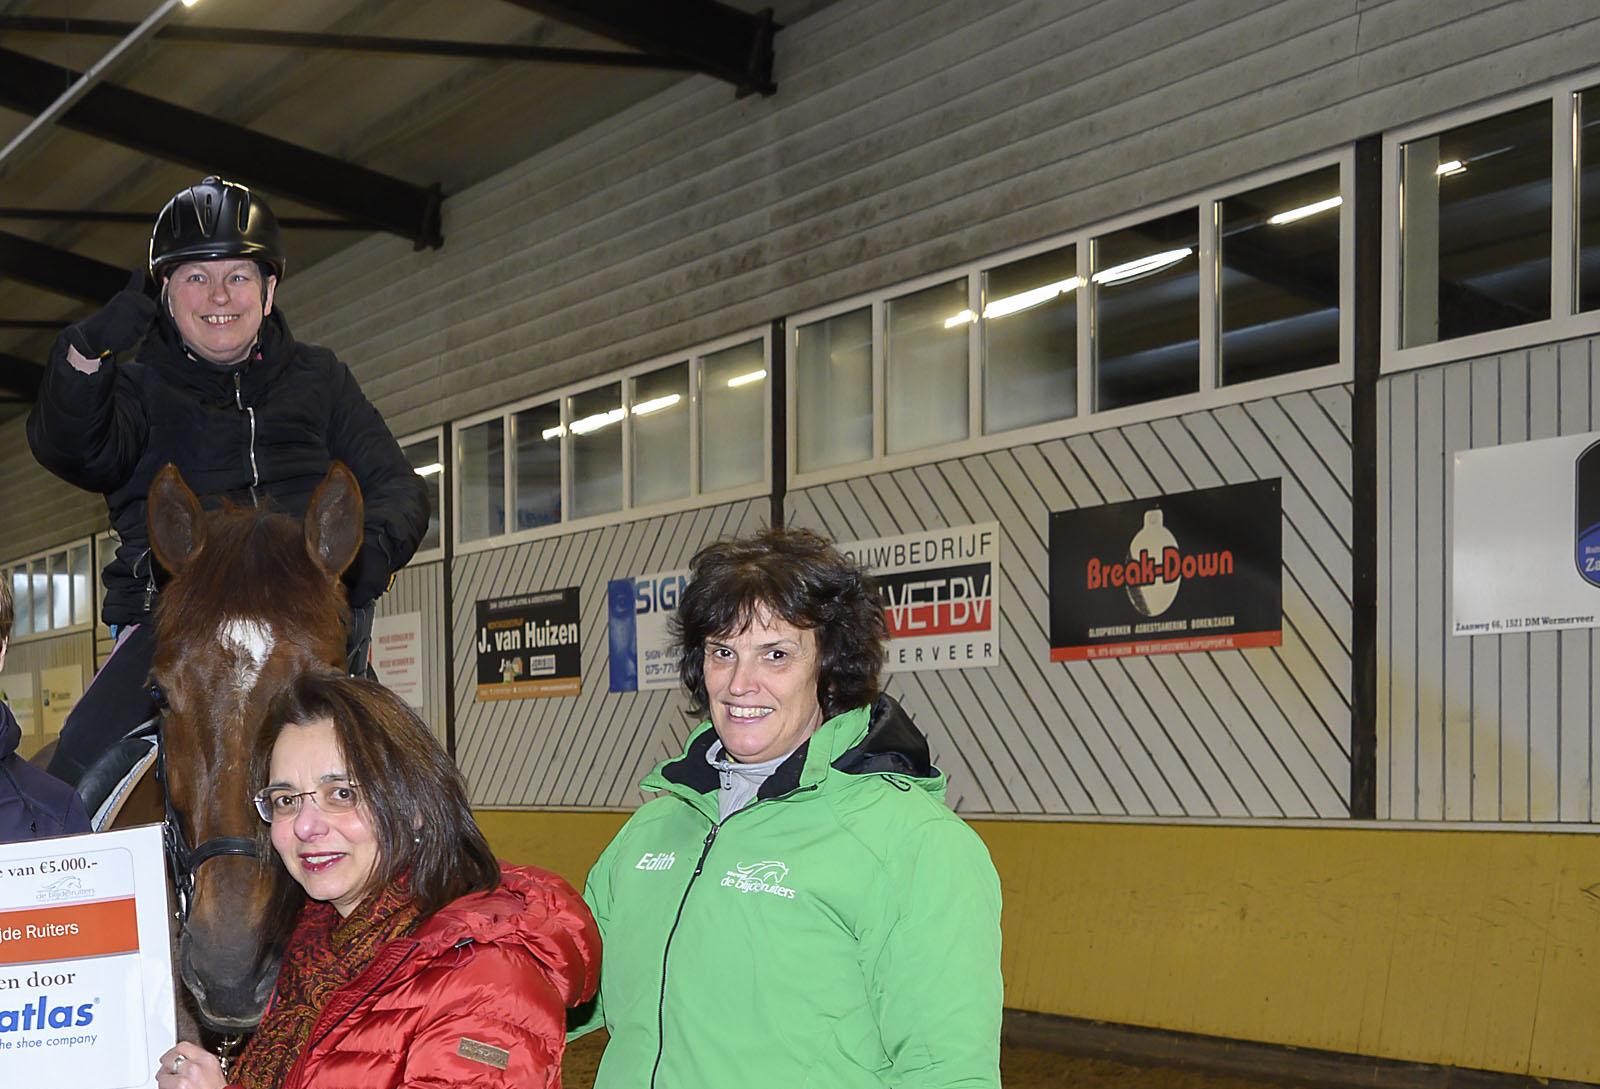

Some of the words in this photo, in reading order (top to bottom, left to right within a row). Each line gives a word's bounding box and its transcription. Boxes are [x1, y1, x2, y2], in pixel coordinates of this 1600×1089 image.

[844, 532, 992, 568] OUWBEDRIJF
[1087, 547, 1233, 590] Break-Down
[1525, 617, 1540, 626] DM
[1541, 615, 1594, 625] Wormerveer
[478, 627, 491, 653] J.
[495, 629, 520, 651] van
[525, 619, 578, 648] Huizen
[887, 643, 992, 663] ERVEER
[8, 866, 35, 878] van
[40, 857, 98, 874] €5.000.-
[635, 851, 676, 871] Edith
[26, 922, 79, 939] Ruiters
[27, 971, 76, 988] door
[16, 1036, 43, 1049] shoe
[46, 1033, 98, 1050] company
